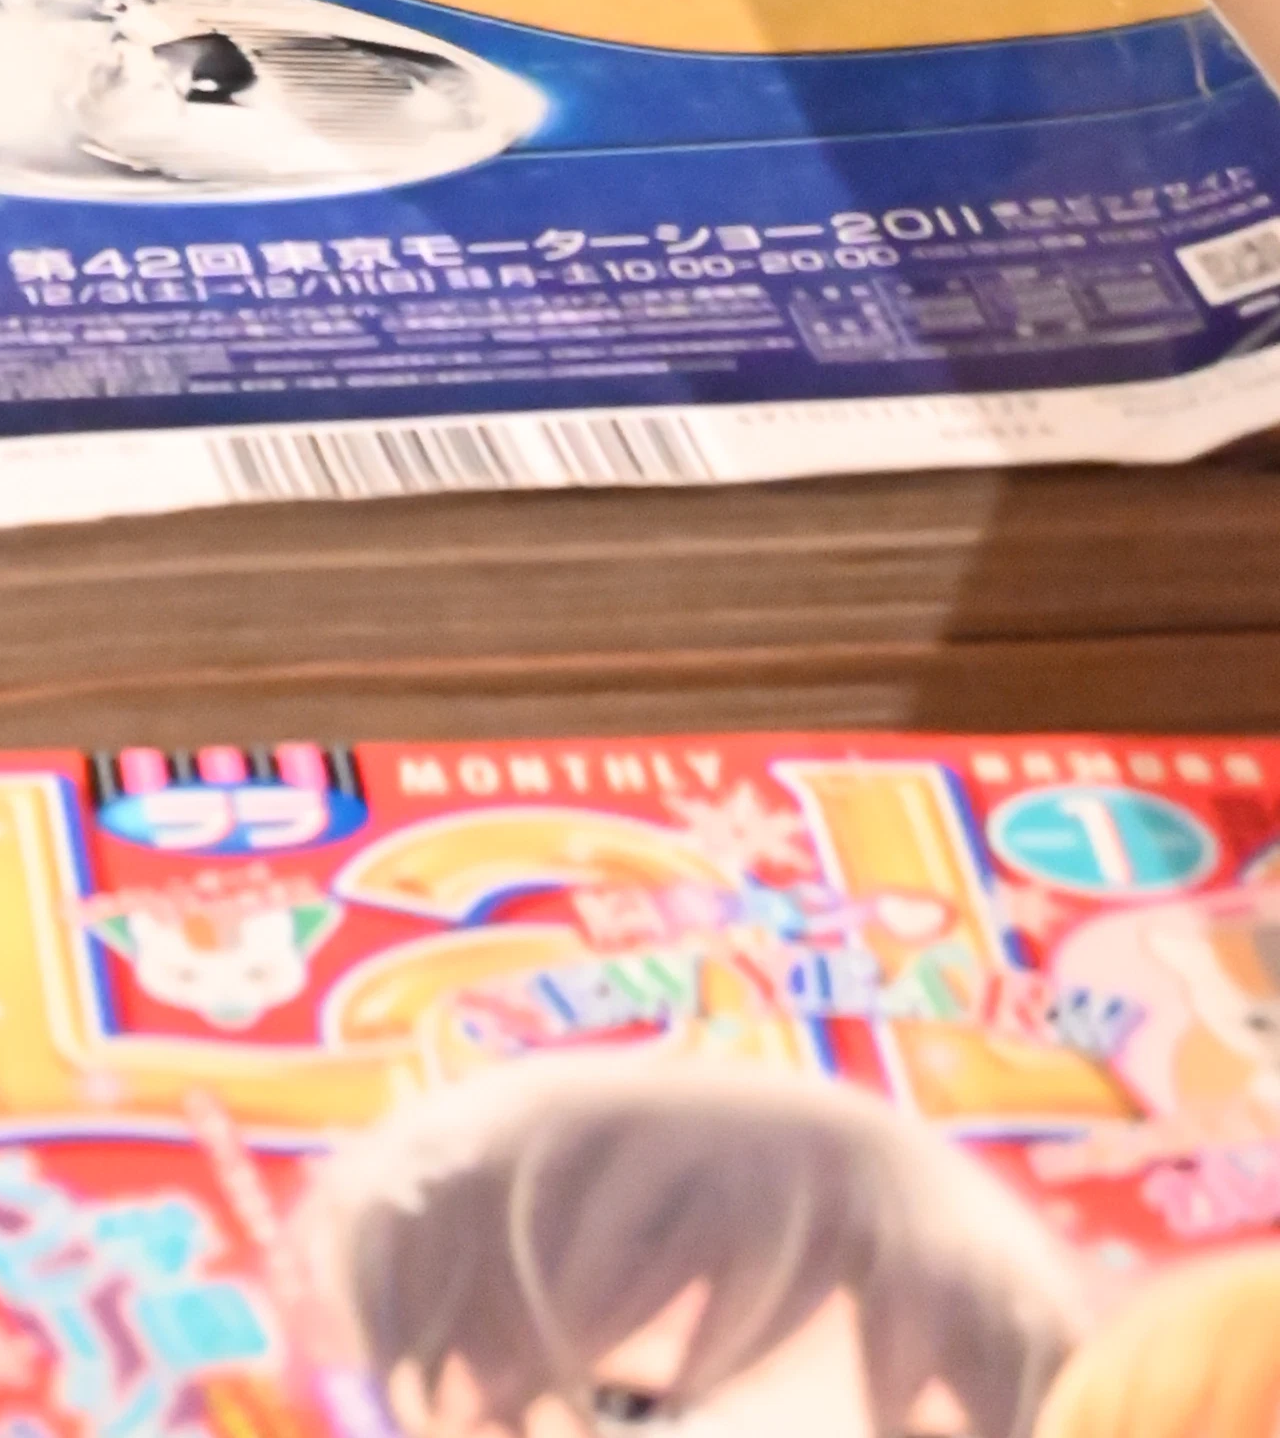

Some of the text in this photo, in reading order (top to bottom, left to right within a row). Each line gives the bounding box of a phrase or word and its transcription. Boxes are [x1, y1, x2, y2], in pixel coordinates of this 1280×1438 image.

[7, 204, 986, 283] 第42回東京モーターショー2011
[397, 751, 728, 798] MONTHLY
